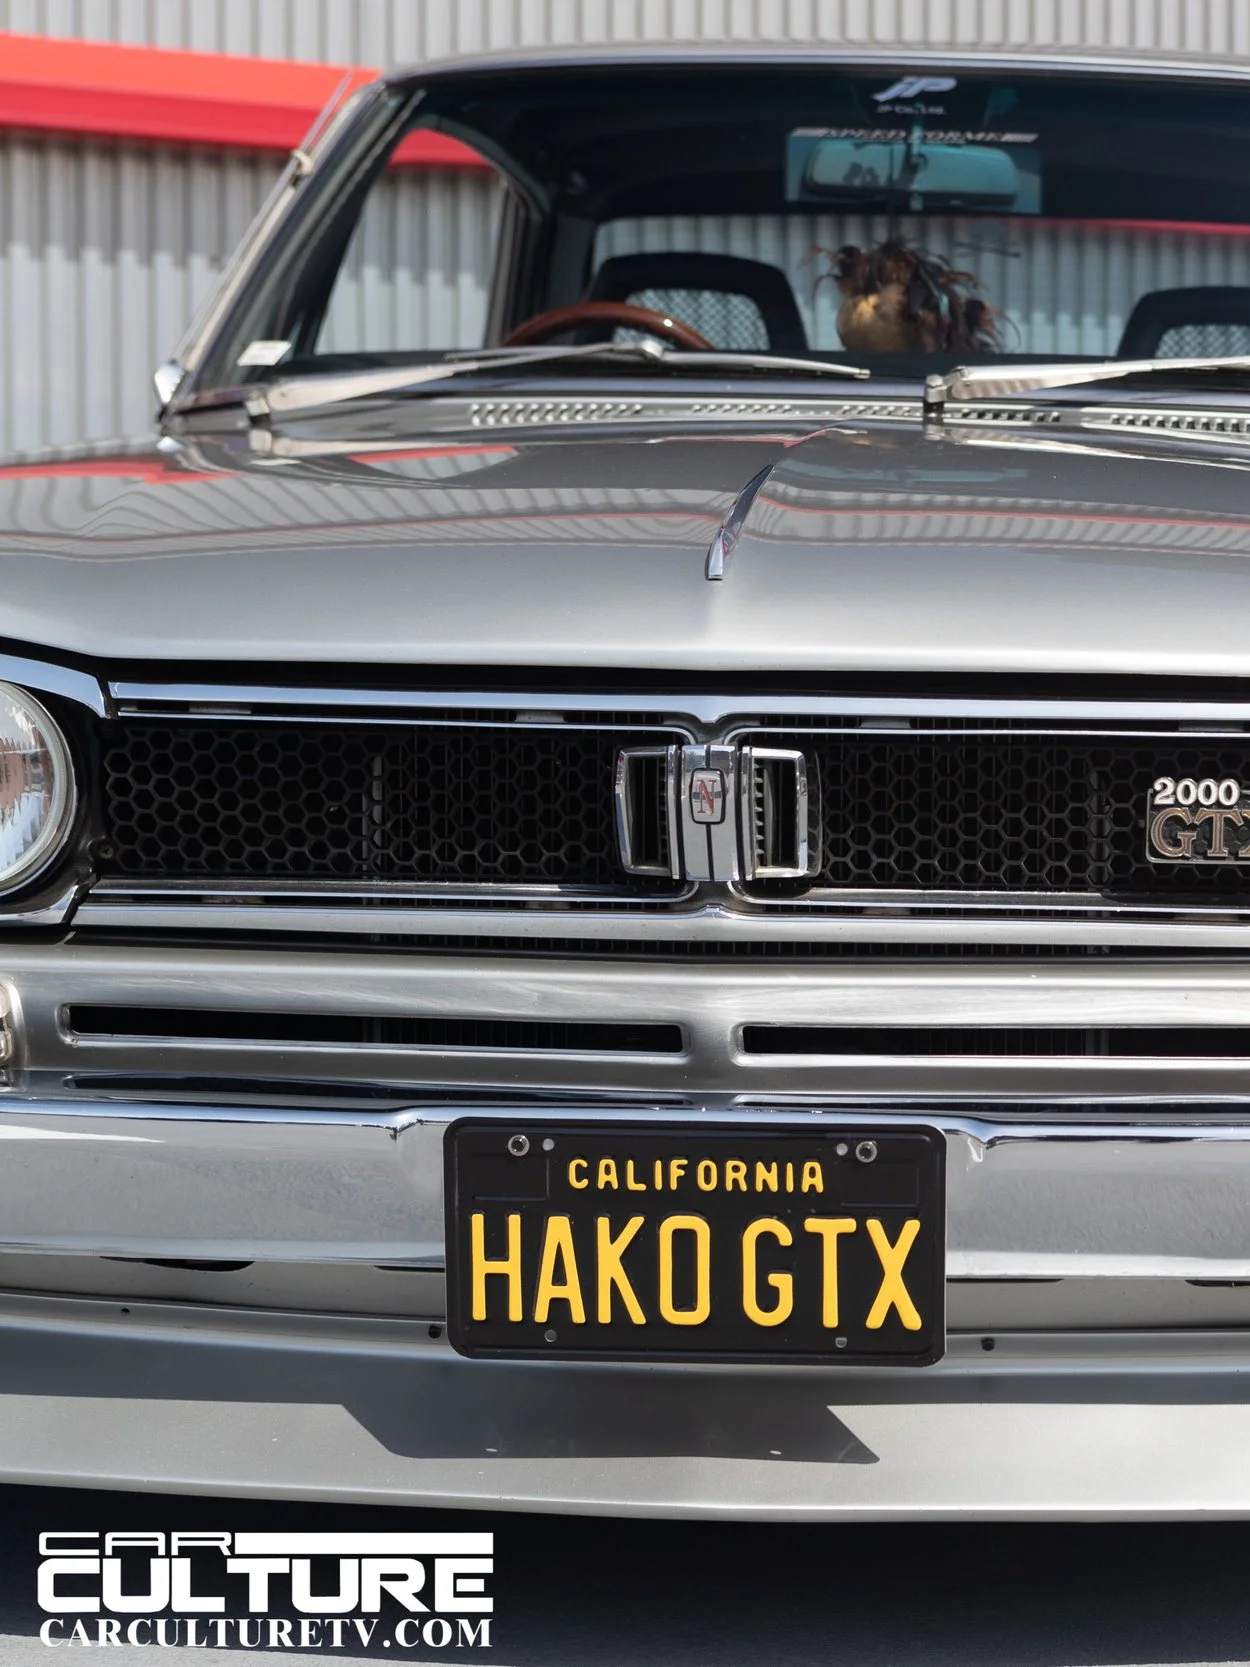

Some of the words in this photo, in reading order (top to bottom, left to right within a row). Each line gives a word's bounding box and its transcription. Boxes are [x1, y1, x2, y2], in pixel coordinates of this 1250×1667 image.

[872, 76, 957, 102] JP
[1153, 777, 1241, 806] 2000
[568, 1158, 825, 1194] CALIFORNIA
[470, 1212, 711, 1326] HAKO
[742, 1217, 923, 1331] GTX
